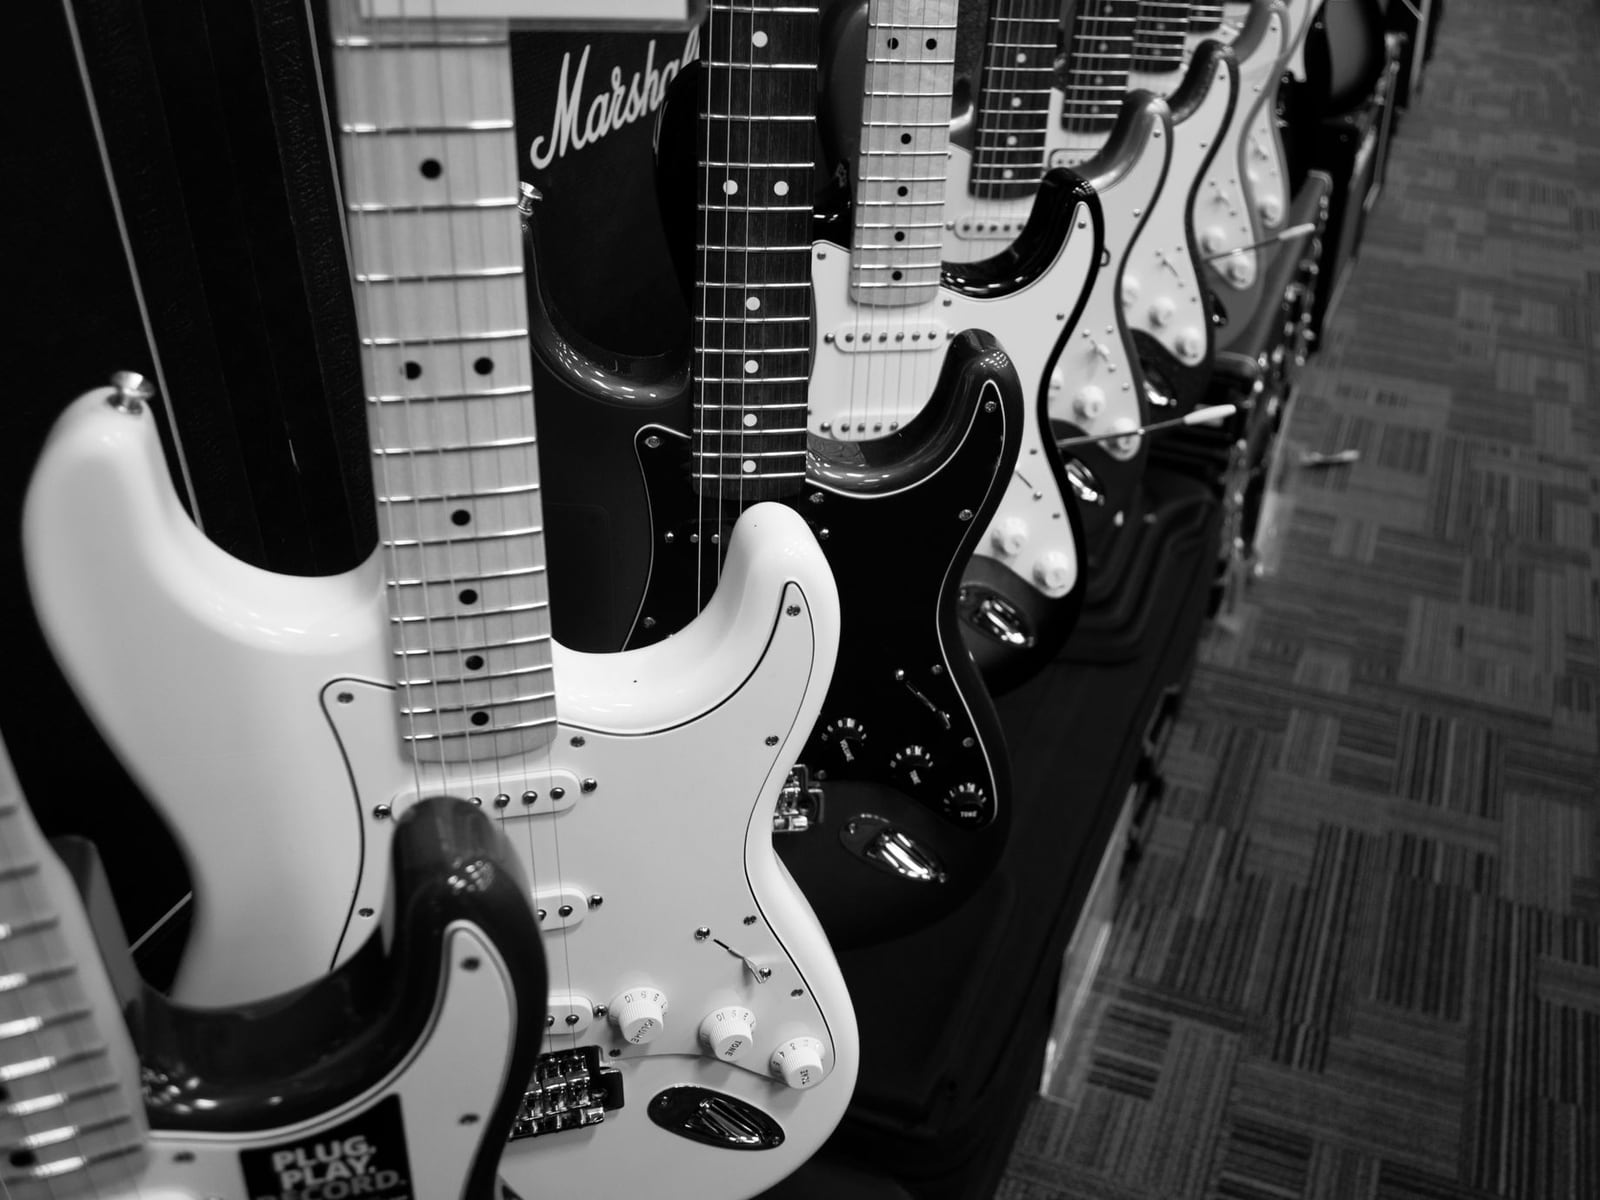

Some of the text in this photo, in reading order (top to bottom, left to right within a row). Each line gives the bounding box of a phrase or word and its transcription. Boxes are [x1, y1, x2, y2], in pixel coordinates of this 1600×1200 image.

[530, 24, 700, 169] Marshal
[724, 1040, 743, 1057] TONE
[272, 1135, 377, 1172] PLUG.
[280, 1154, 377, 1190] PLAY.
